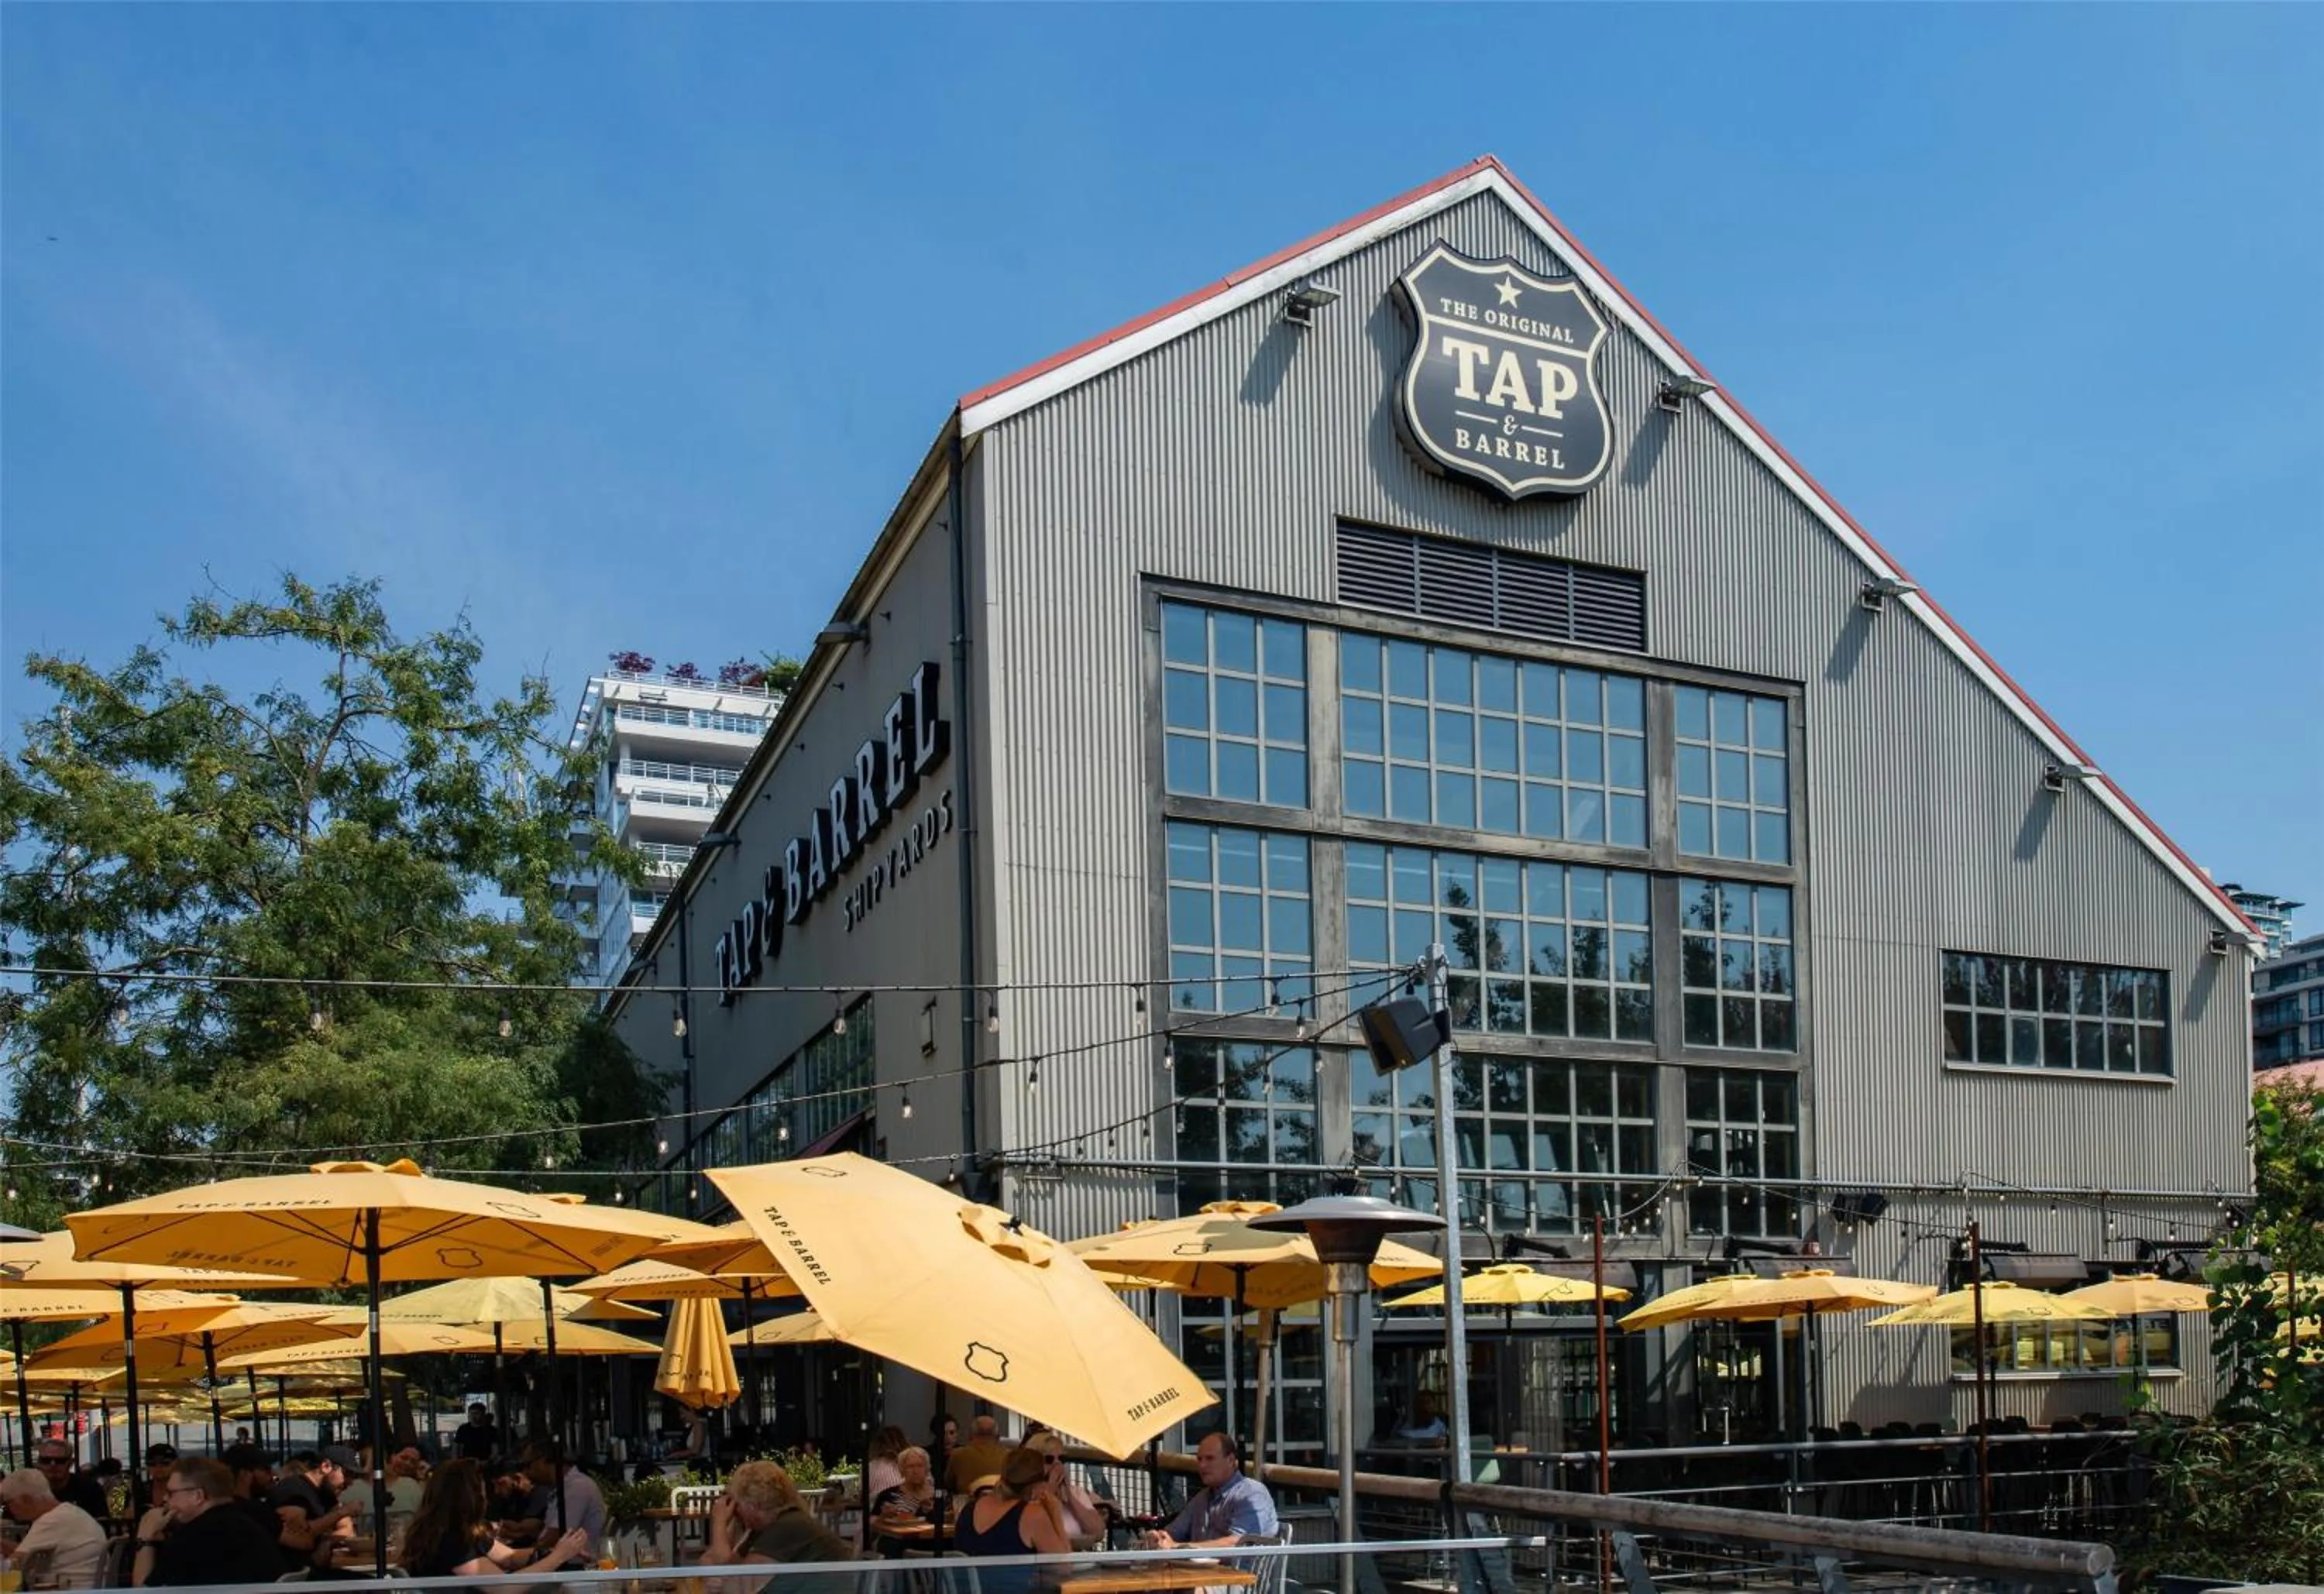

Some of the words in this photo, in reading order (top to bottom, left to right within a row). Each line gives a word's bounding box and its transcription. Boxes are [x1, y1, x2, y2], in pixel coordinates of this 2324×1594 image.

[1440, 297, 1478, 320] THE
[1484, 309, 1574, 344] ORIGINAL
[1442, 336, 1578, 419] TAP
[1456, 428, 1565, 469] BARREL
[1503, 414, 1519, 435] &
[715, 901, 758, 1005] TAP
[761, 866, 779, 957] &
[784, 663, 942, 926] BARREL
[844, 789, 952, 933] SHIPYARDS
[764, 1206, 789, 1228] TAP
[789, 1238, 831, 1285] BARREL
[1127, 1404, 1144, 1421] TAP
[1148, 1387, 1180, 1409] BARREL
